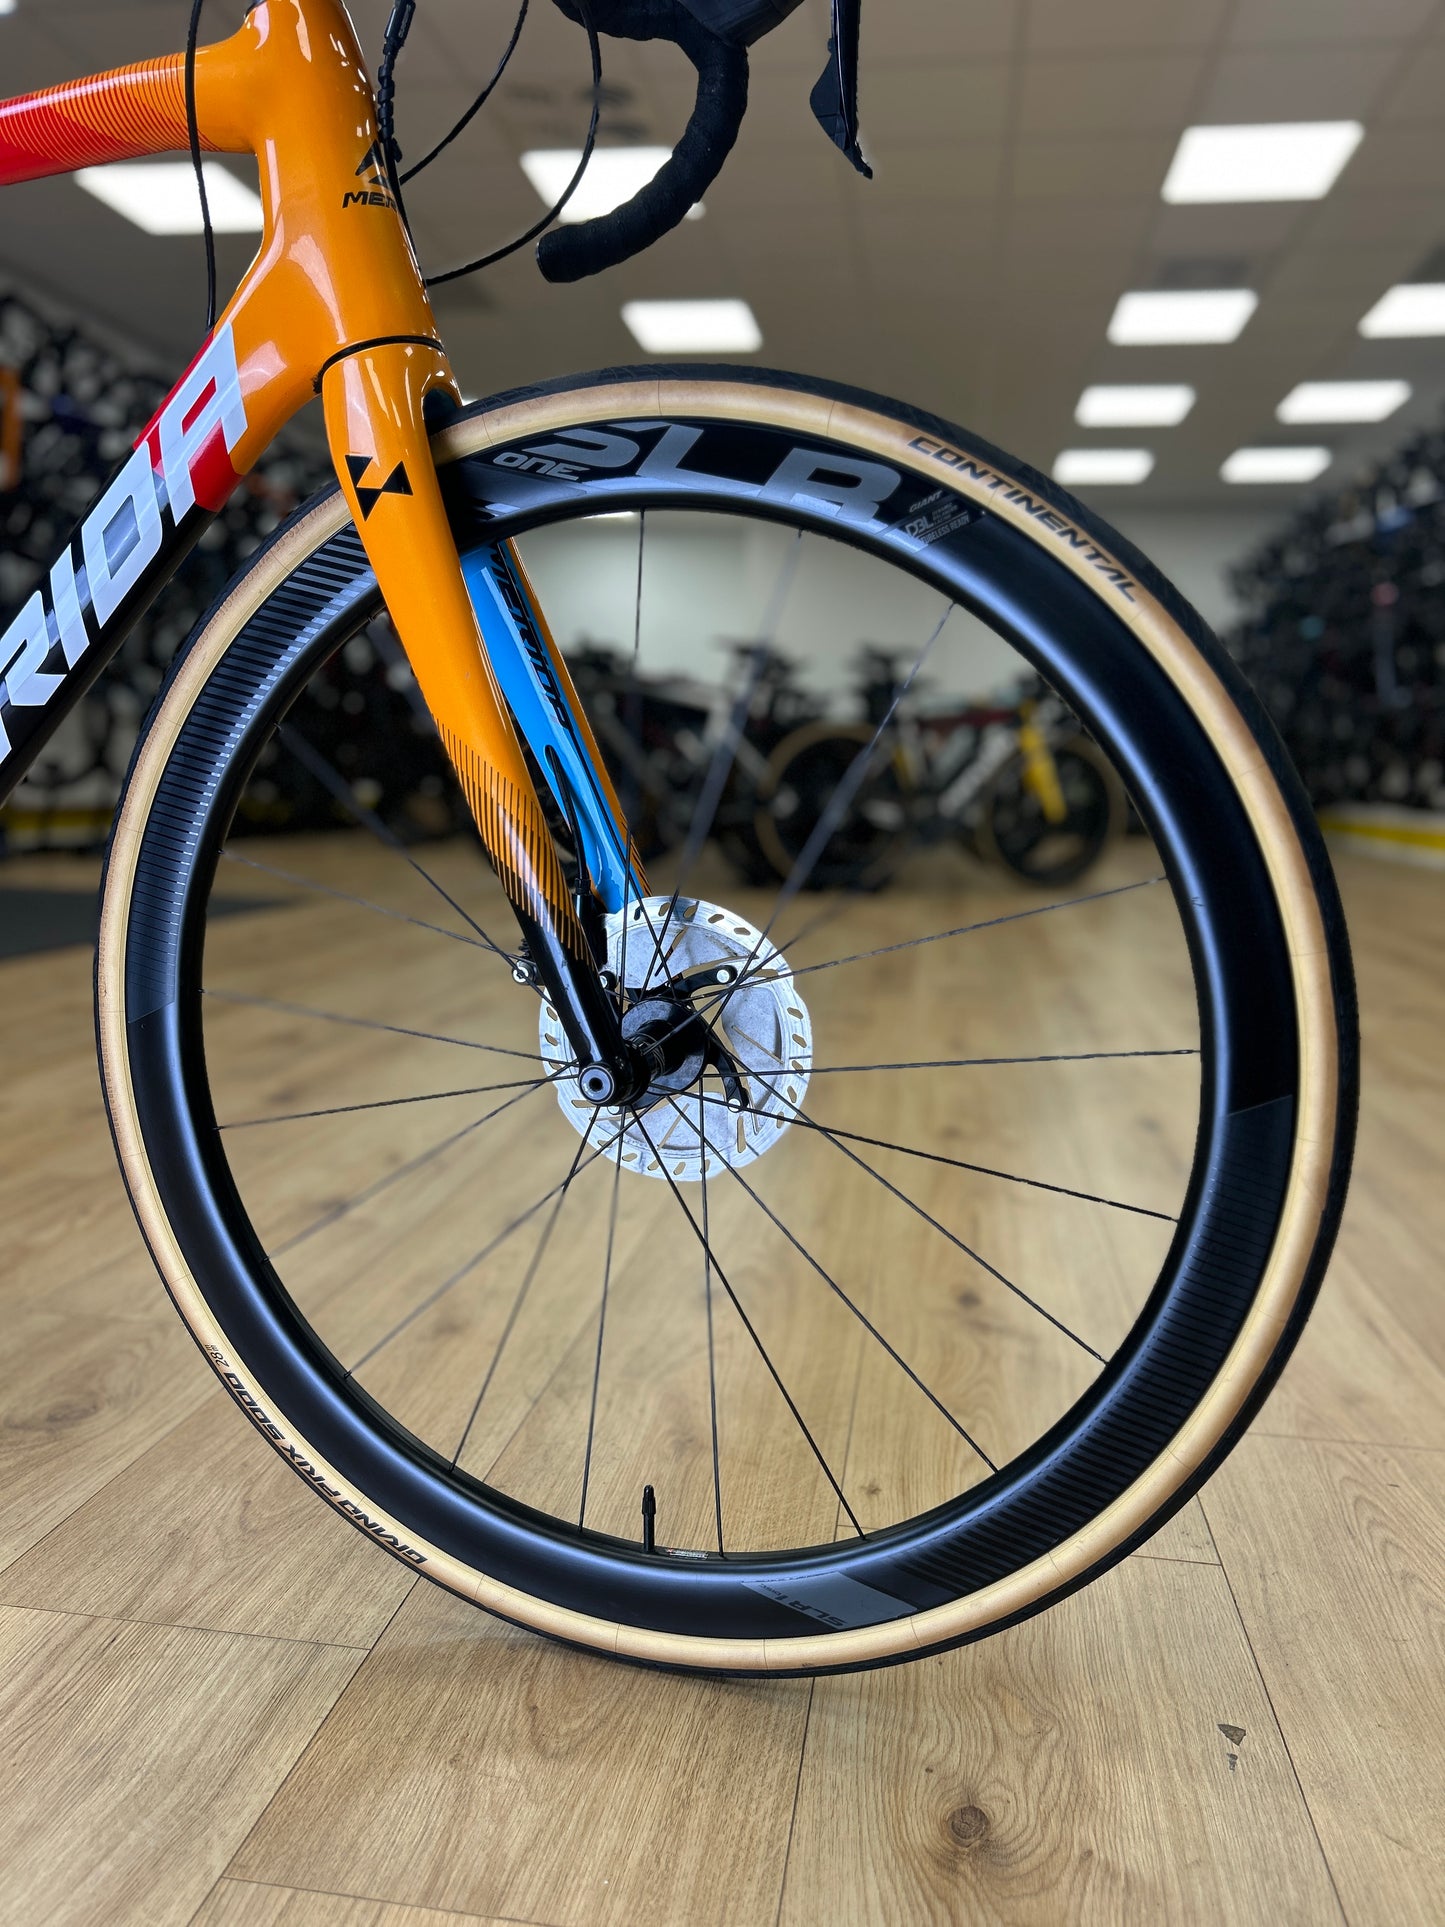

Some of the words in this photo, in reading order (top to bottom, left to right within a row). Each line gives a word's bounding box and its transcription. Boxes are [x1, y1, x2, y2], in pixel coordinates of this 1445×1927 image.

[493, 451, 591, 481] ONE
[521, 421, 901, 523] SLR
[907, 435, 1136, 603] CONTINENTAL
[909, 490, 943, 513] GIANT
[950, 514, 971, 532] READY
[210, 1351, 230, 1368] 28
[224, 1371, 286, 1441] 5000
[281, 1444, 340, 1498] PRIX
[338, 1499, 429, 1565] GRAND
[789, 1600, 848, 1627] SLR
